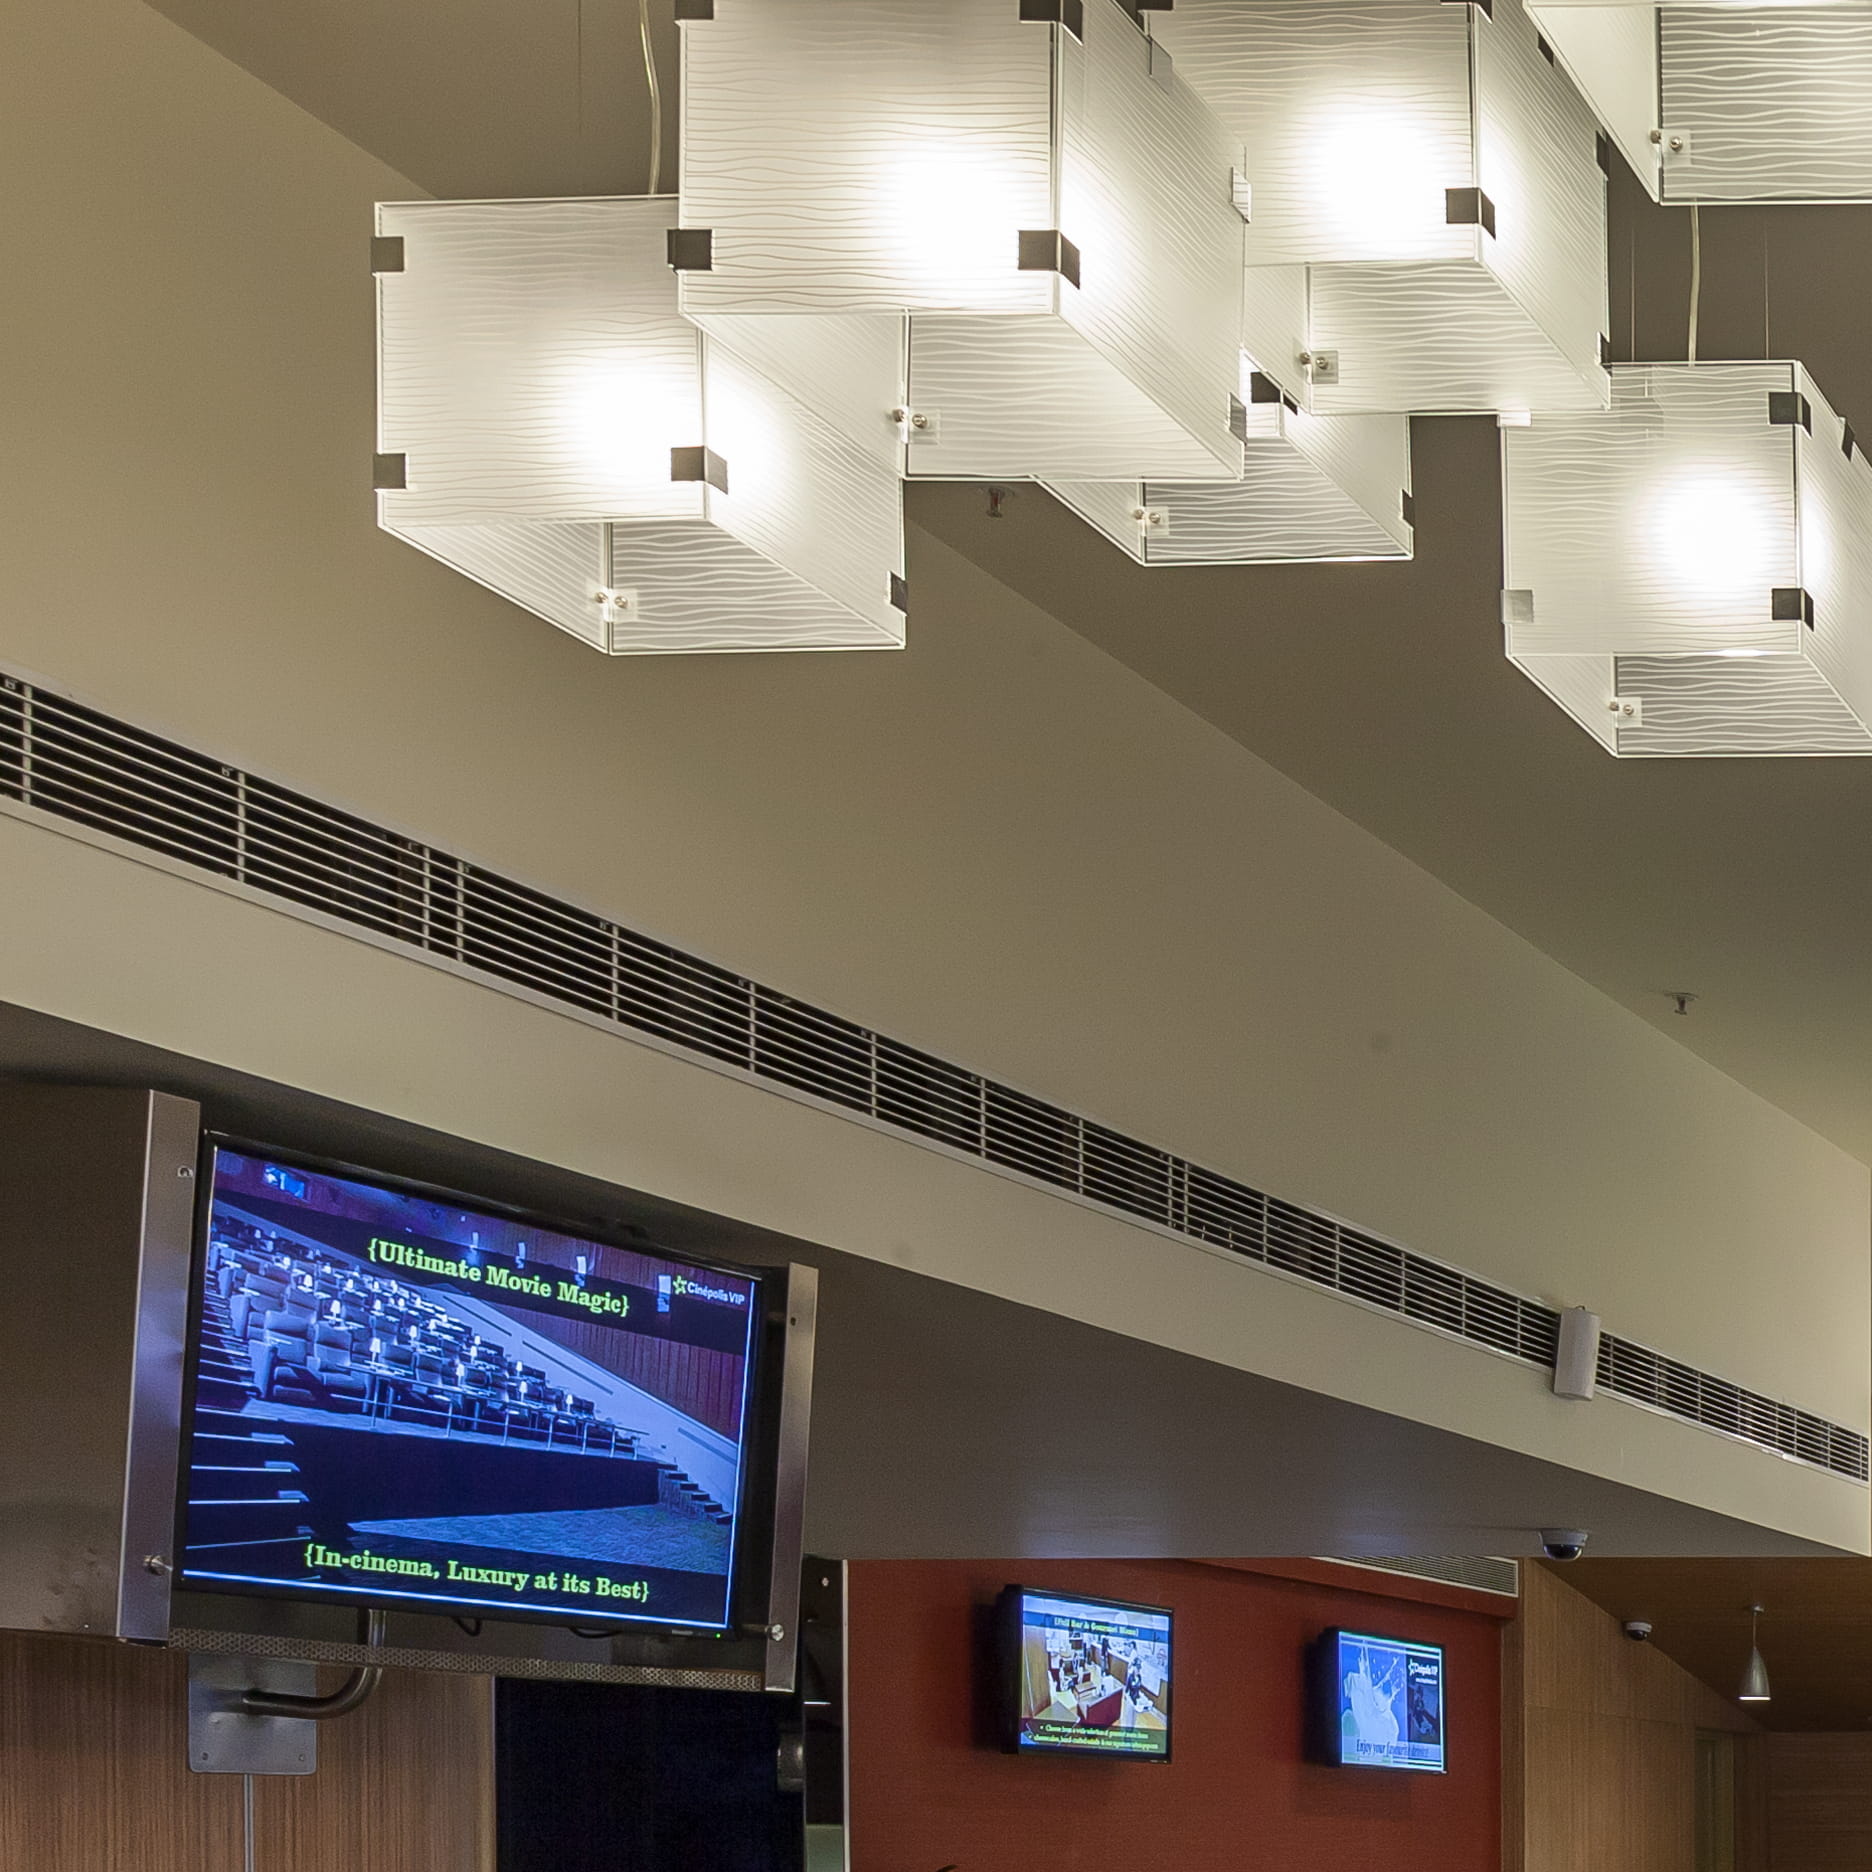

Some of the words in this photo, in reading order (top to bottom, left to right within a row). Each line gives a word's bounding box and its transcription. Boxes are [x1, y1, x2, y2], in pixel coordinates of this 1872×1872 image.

[368, 1238, 481, 1281] {Ultimate
[486, 1265, 552, 1297] Movie
[557, 1281, 630, 1317] Magic}
[729, 1291, 745, 1305] VIP
[447, 1560, 530, 1592] Luxury
[534, 1572, 557, 1591] at
[561, 1573, 591, 1594] its
[596, 1577, 650, 1603] Best}
